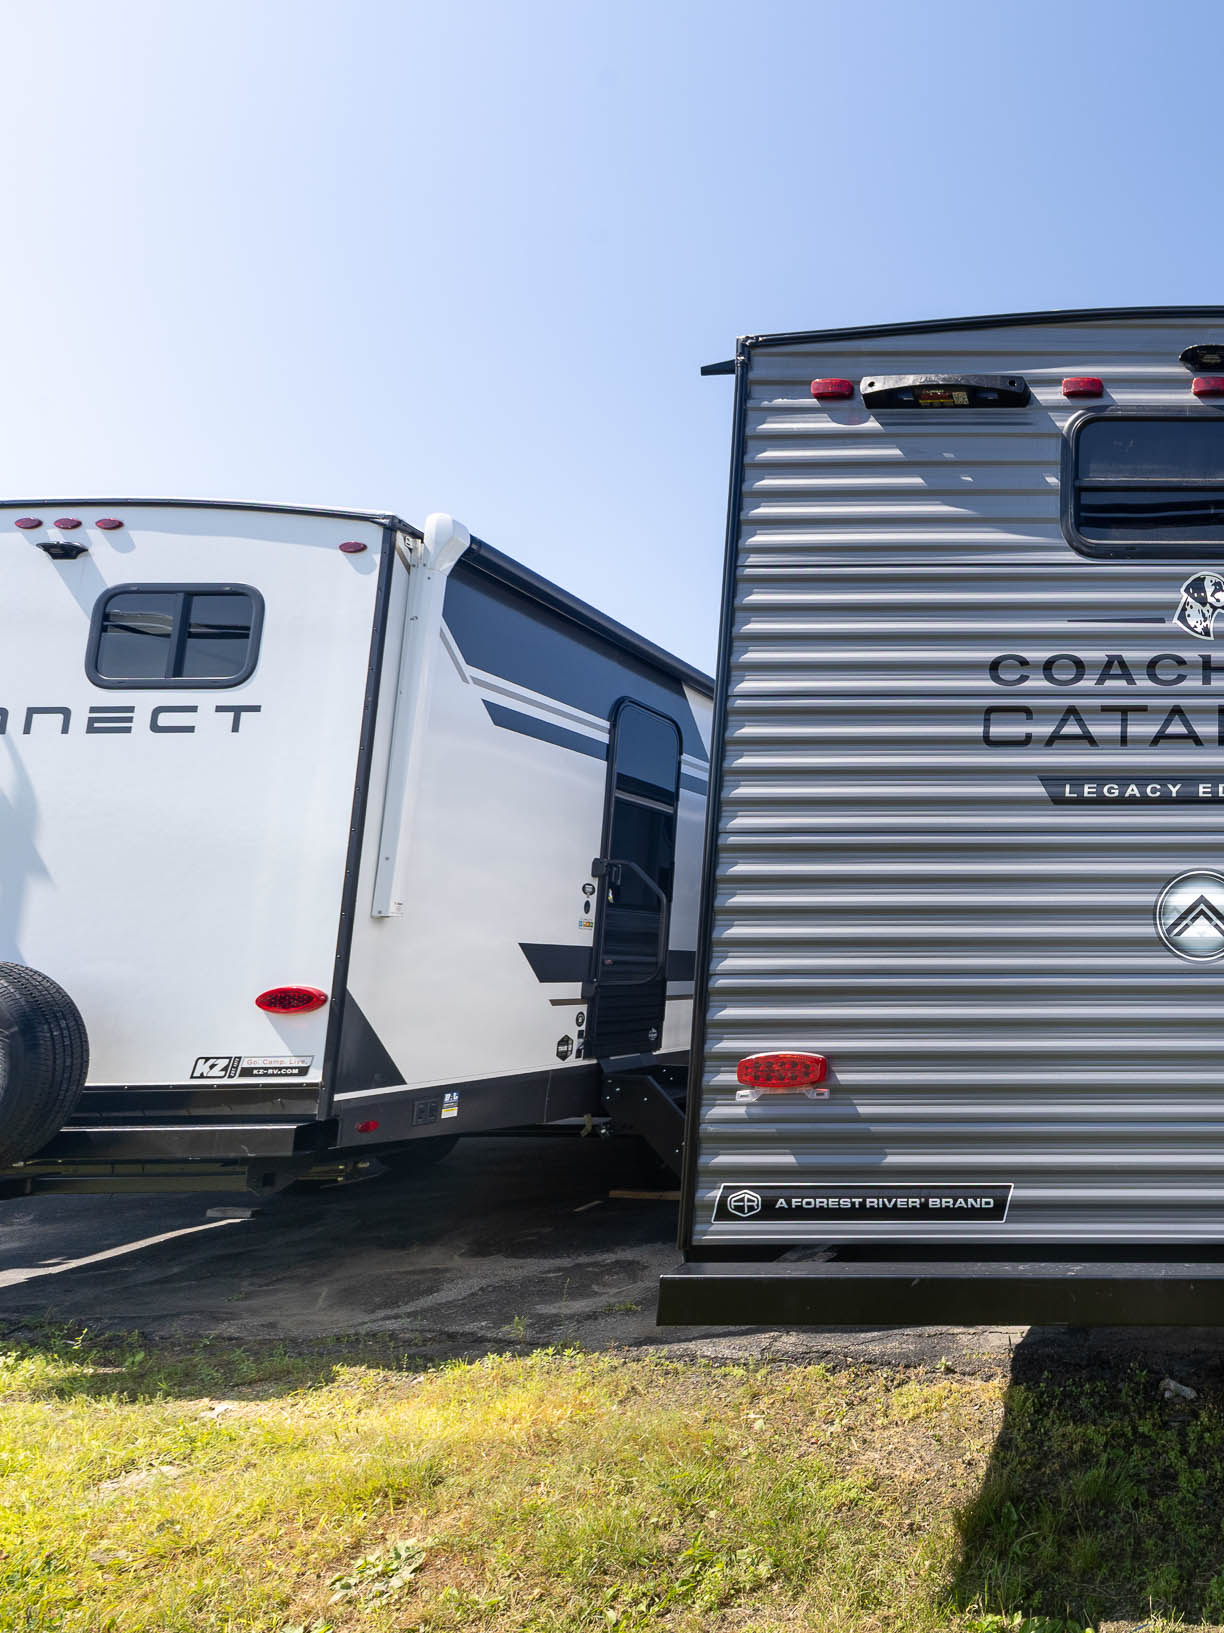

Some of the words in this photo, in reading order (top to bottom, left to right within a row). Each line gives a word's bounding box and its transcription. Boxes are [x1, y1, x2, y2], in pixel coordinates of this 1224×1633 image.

[1064, 783, 1182, 798] LEGACY
[192, 1058, 231, 1077] KZ
[775, 1198, 792, 1208] A
[792, 1198, 863, 1209] FOREST
[929, 1198, 994, 1209] BRAND
